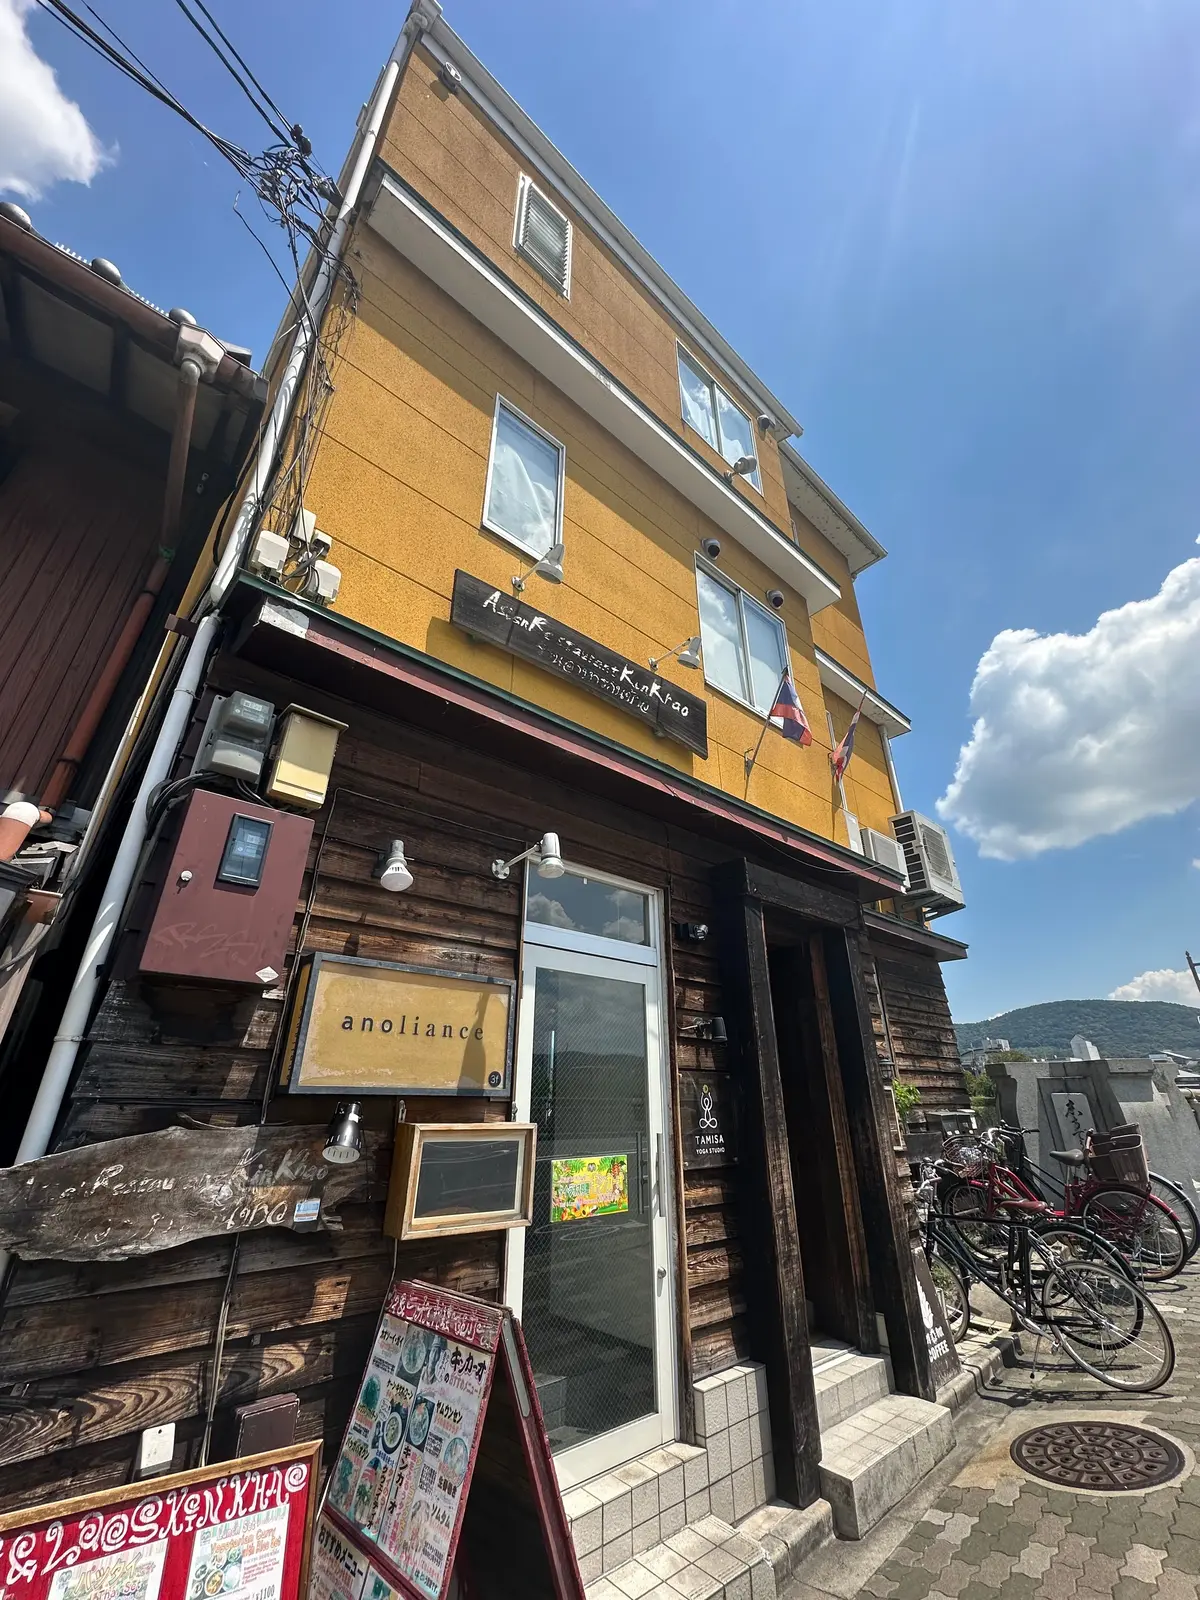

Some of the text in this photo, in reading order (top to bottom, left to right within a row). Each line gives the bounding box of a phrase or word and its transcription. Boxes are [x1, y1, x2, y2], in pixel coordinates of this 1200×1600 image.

[341, 1015, 484, 1040] anoliance
[695, 1134, 725, 1145] TAMISA
[709, 1146, 725, 1154] STUDIO
[928, 1340, 949, 1363] COFFEE
